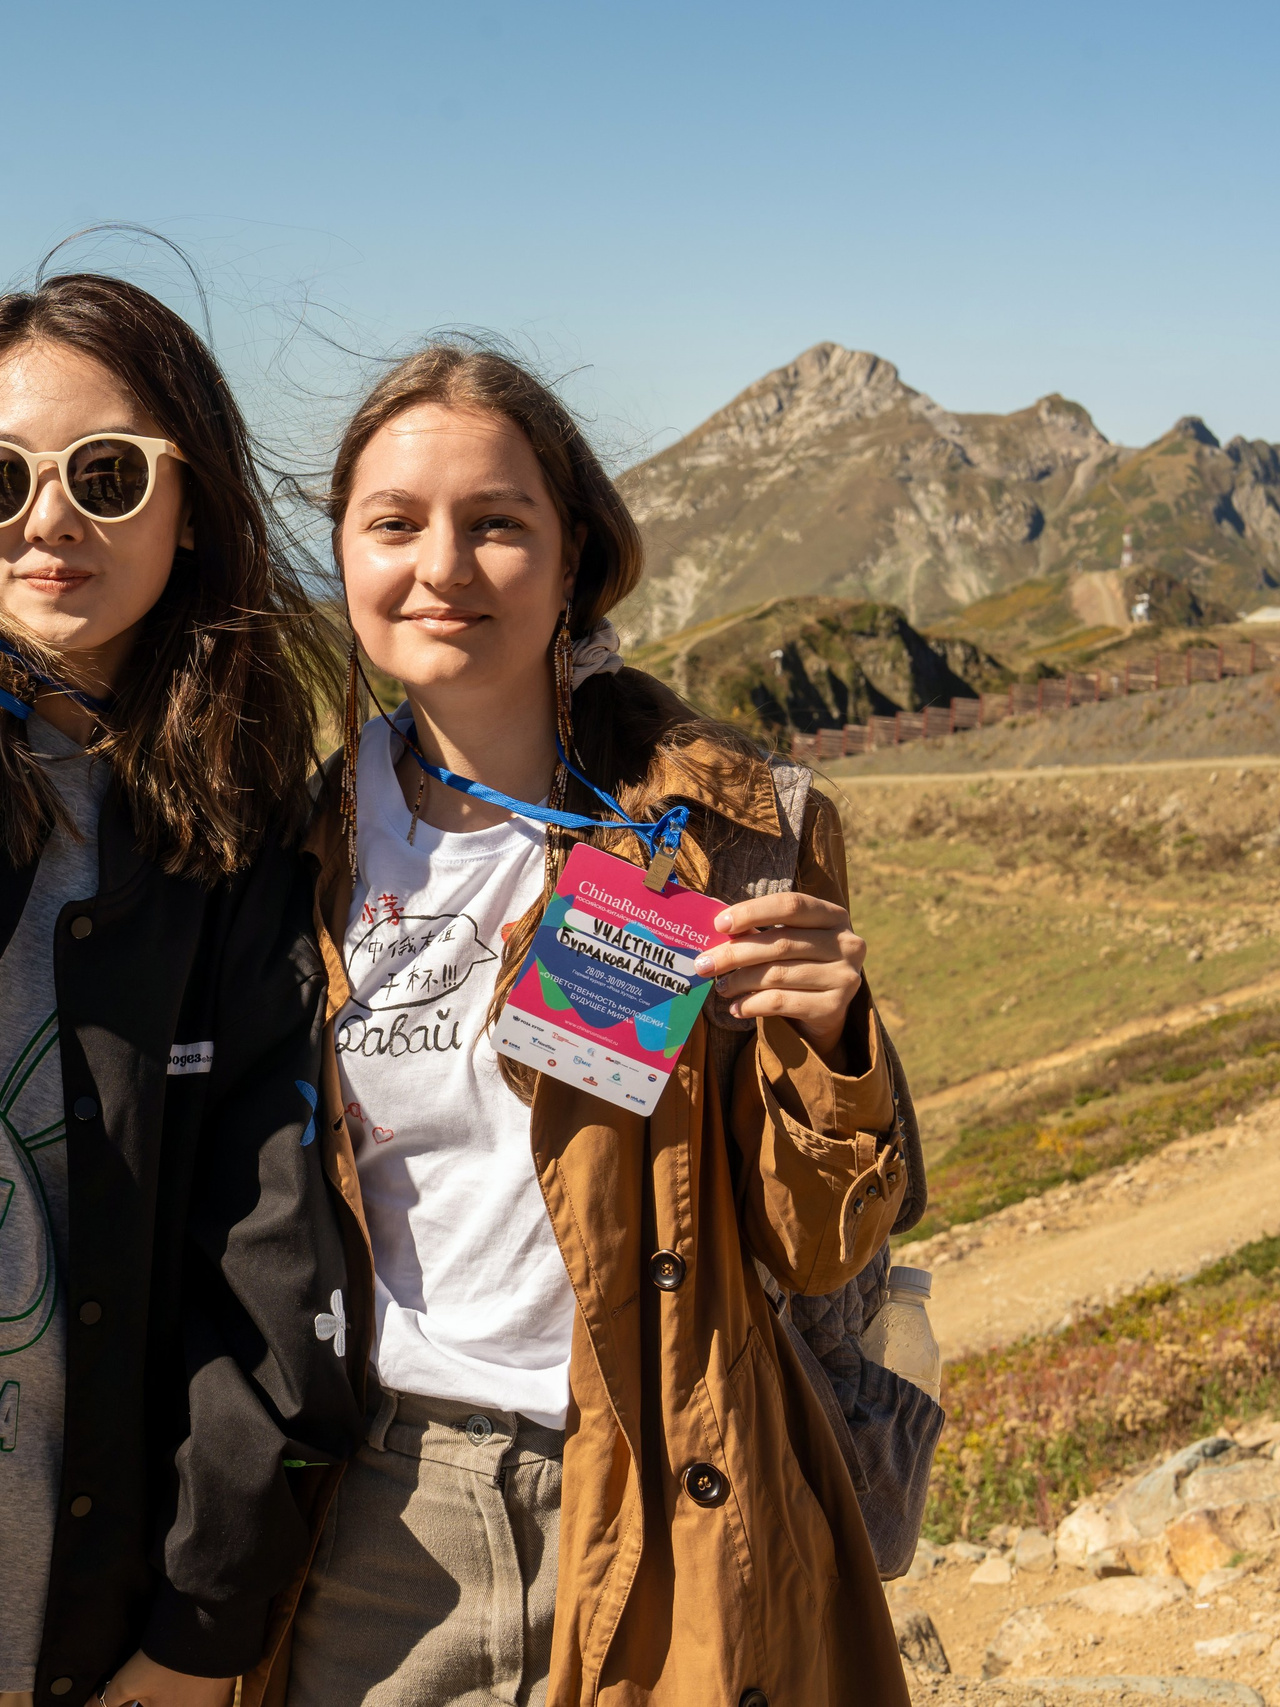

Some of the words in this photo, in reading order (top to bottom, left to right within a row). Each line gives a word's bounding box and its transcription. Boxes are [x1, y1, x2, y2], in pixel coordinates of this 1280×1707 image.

[578, 880, 711, 947] ChinaRusRosaFest
[590, 918, 679, 969] УЧАСТНИК
[539, 970, 617, 1009] «ОТВЕТСТВЕННОСТЬ
[618, 1004, 664, 1029] МОЛОДЕЖИ
[570, 993, 606, 1013] БУДУЩЕЕ
[585, 966, 643, 997] 28/09-30/09/2024
[335, 1008, 462, 1057] Давай
